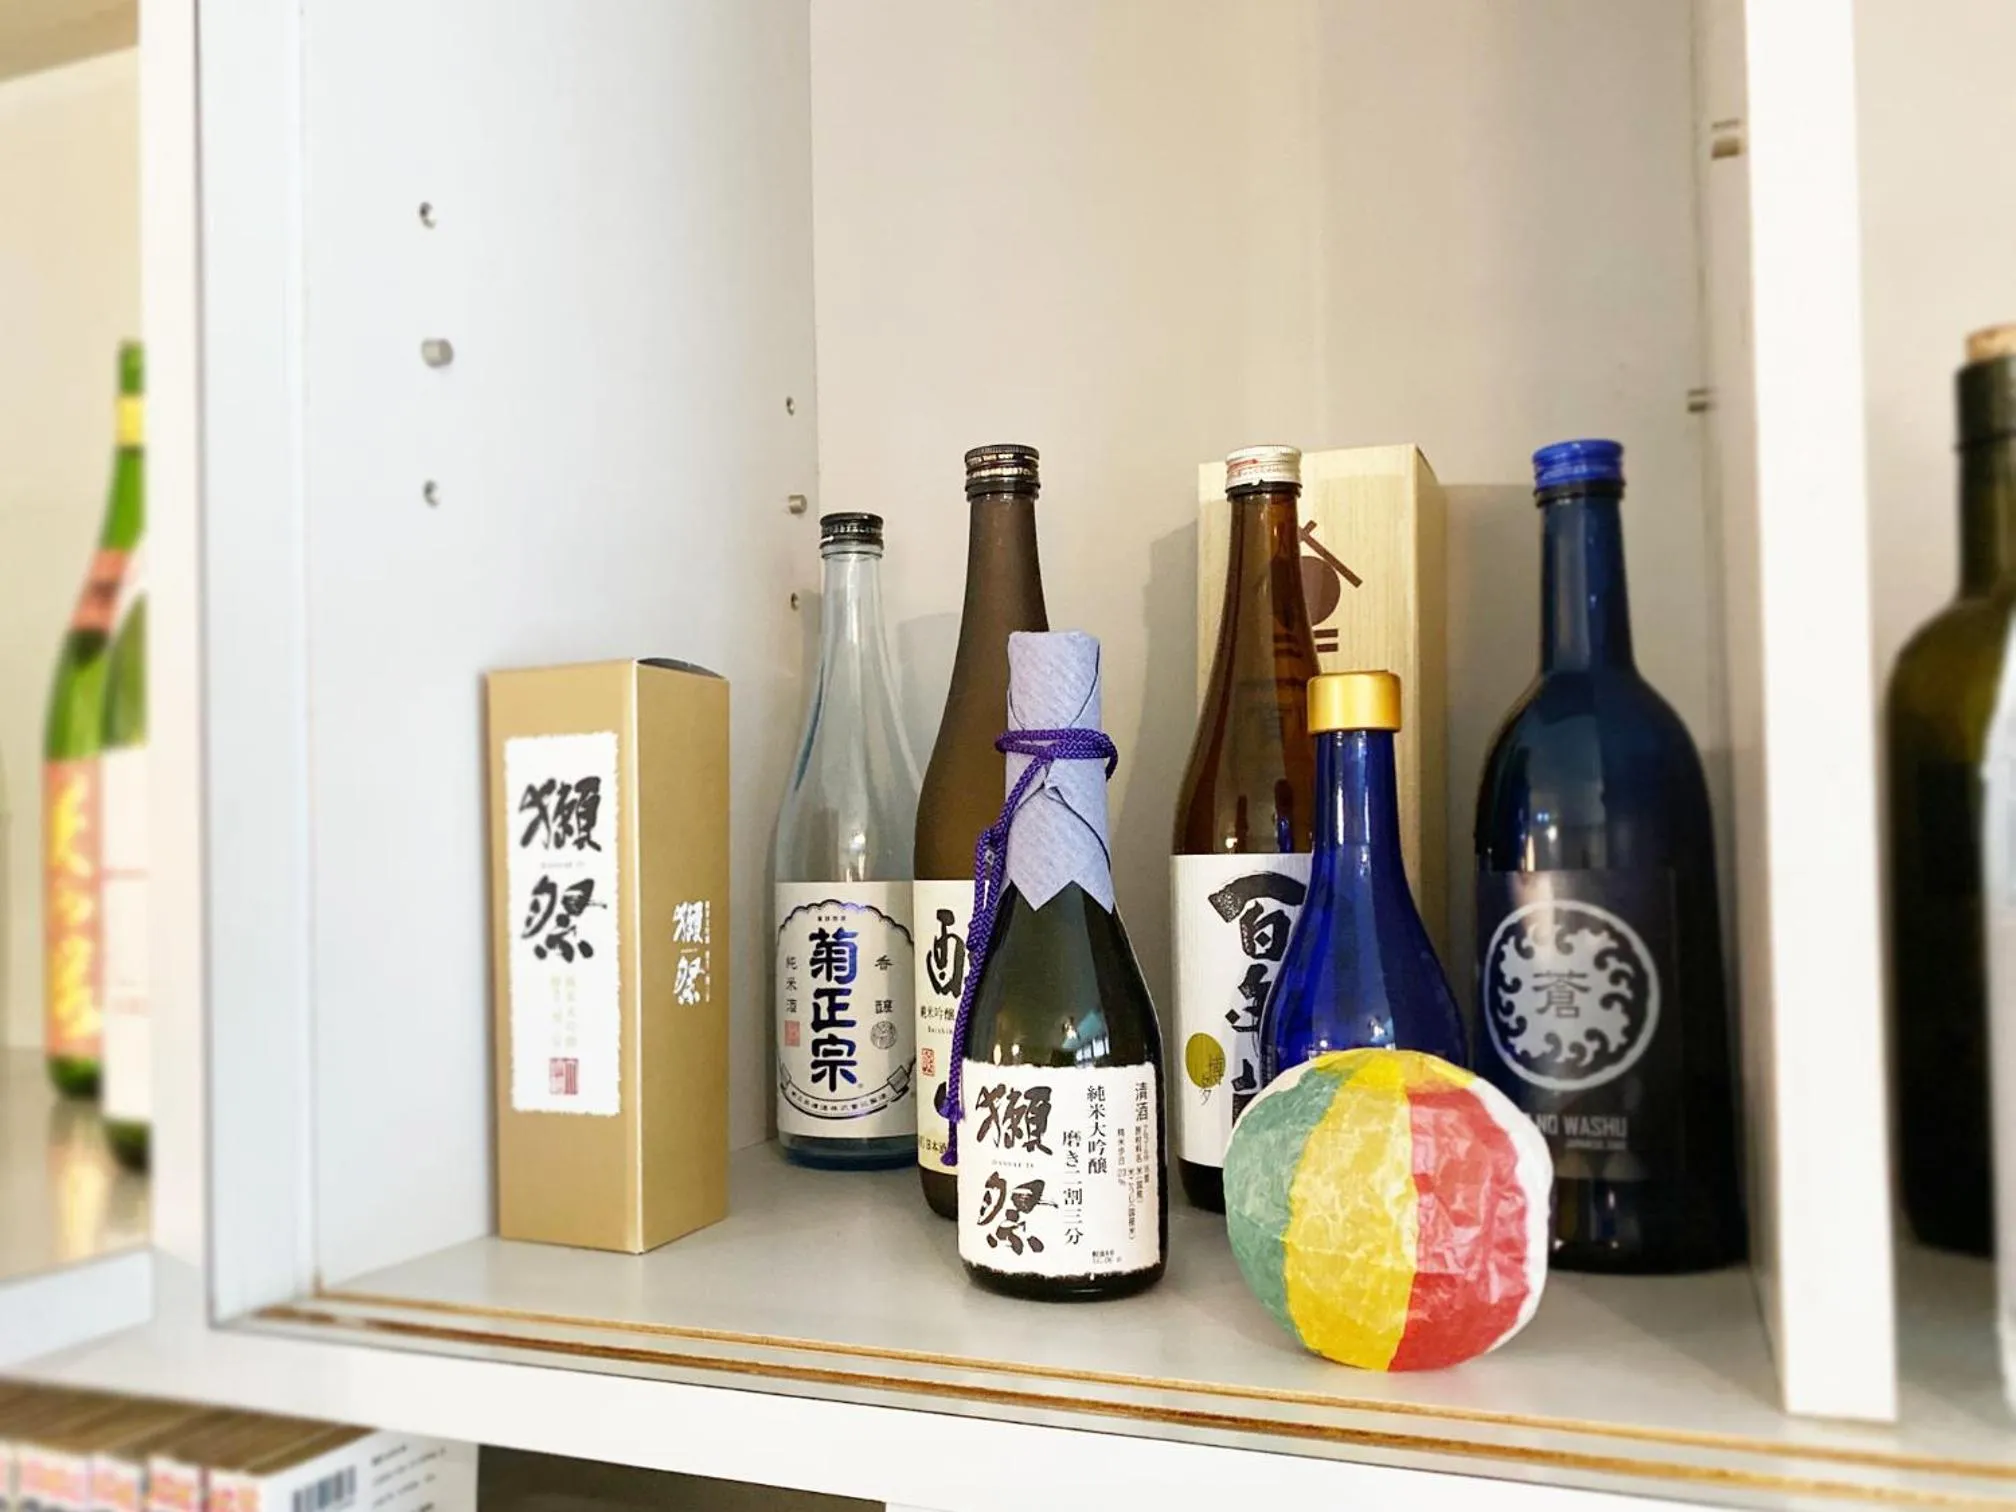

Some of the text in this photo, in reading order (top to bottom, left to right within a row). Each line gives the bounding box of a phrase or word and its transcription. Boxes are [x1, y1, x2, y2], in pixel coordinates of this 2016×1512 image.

[519, 776, 607, 964] 獺祭
[673, 900, 705, 1005] 獺祭
[785, 956, 798, 1014] 純米酒
[1532, 970, 1592, 1019] 蒼
[809, 926, 859, 1093] 菊正宗
[1087, 1085, 1107, 1175] 純米大吟醸
[1135, 1082, 1149, 1121] 清酒
[1563, 1115, 1627, 1137] WASHU
[976, 1083, 1059, 1256] 獺祭
[1062, 1130, 1083, 1246] 磨き二割三分
